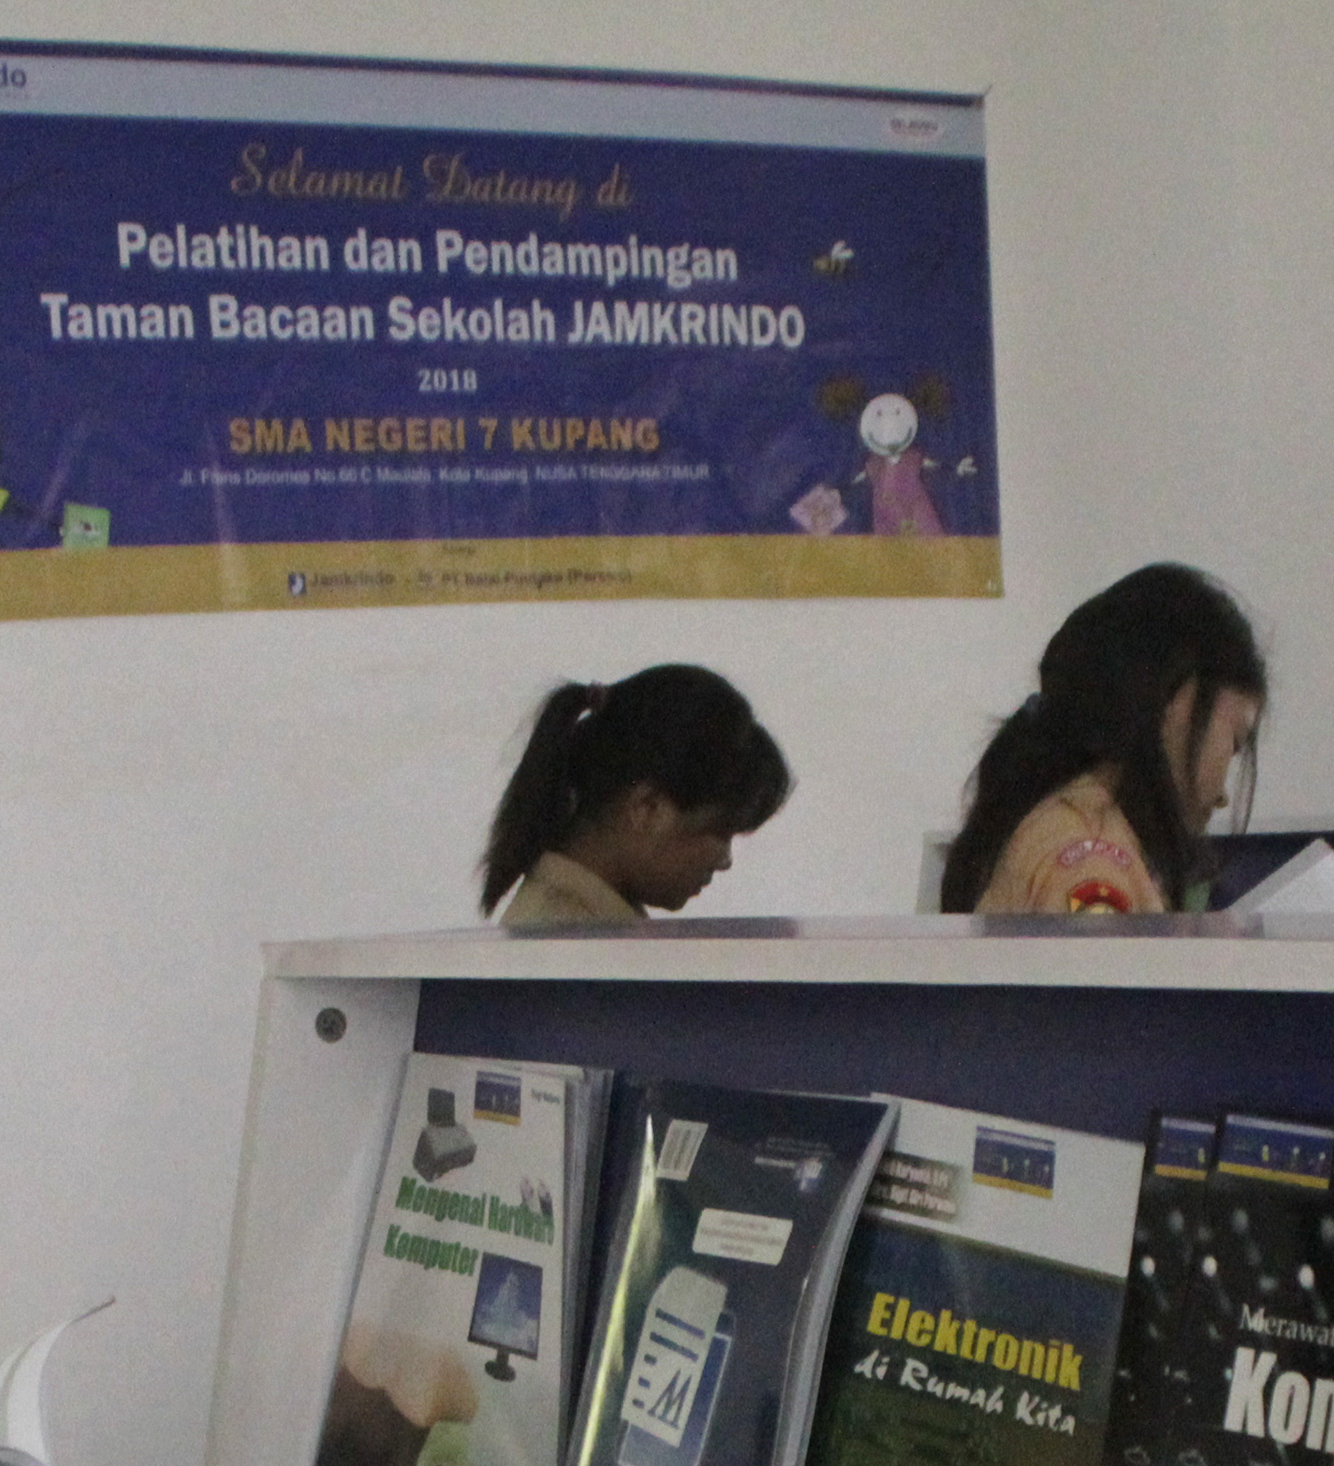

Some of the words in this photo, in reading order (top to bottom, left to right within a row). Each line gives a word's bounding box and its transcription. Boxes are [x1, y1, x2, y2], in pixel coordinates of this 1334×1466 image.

[229, 142, 408, 201] Selamat
[423, 152, 581, 222] Datang
[597, 162, 634, 208] di
[116, 222, 330, 272] Pelatihan
[344, 228, 422, 273] dan
[435, 229, 739, 288] Pendampingan
[41, 293, 194, 340] Taman
[208, 294, 375, 341] Bacaan
[388, 296, 556, 343] Sekolah
[568, 300, 806, 348] JAMKRINDO
[417, 368, 479, 393] 2018
[228, 418, 313, 454] SMA
[325, 417, 466, 453] NEGERI
[478, 417, 500, 452] 7
[511, 416, 662, 453] KUPANG
[395, 1176, 487, 1228] Mengenal
[384, 1223, 479, 1277] Komputer
[865, 1291, 1084, 1392] Elektronik
[854, 1355, 888, 1382] di
[900, 1361, 1004, 1416] Rumah
[1014, 1388, 1076, 1436] Kita
